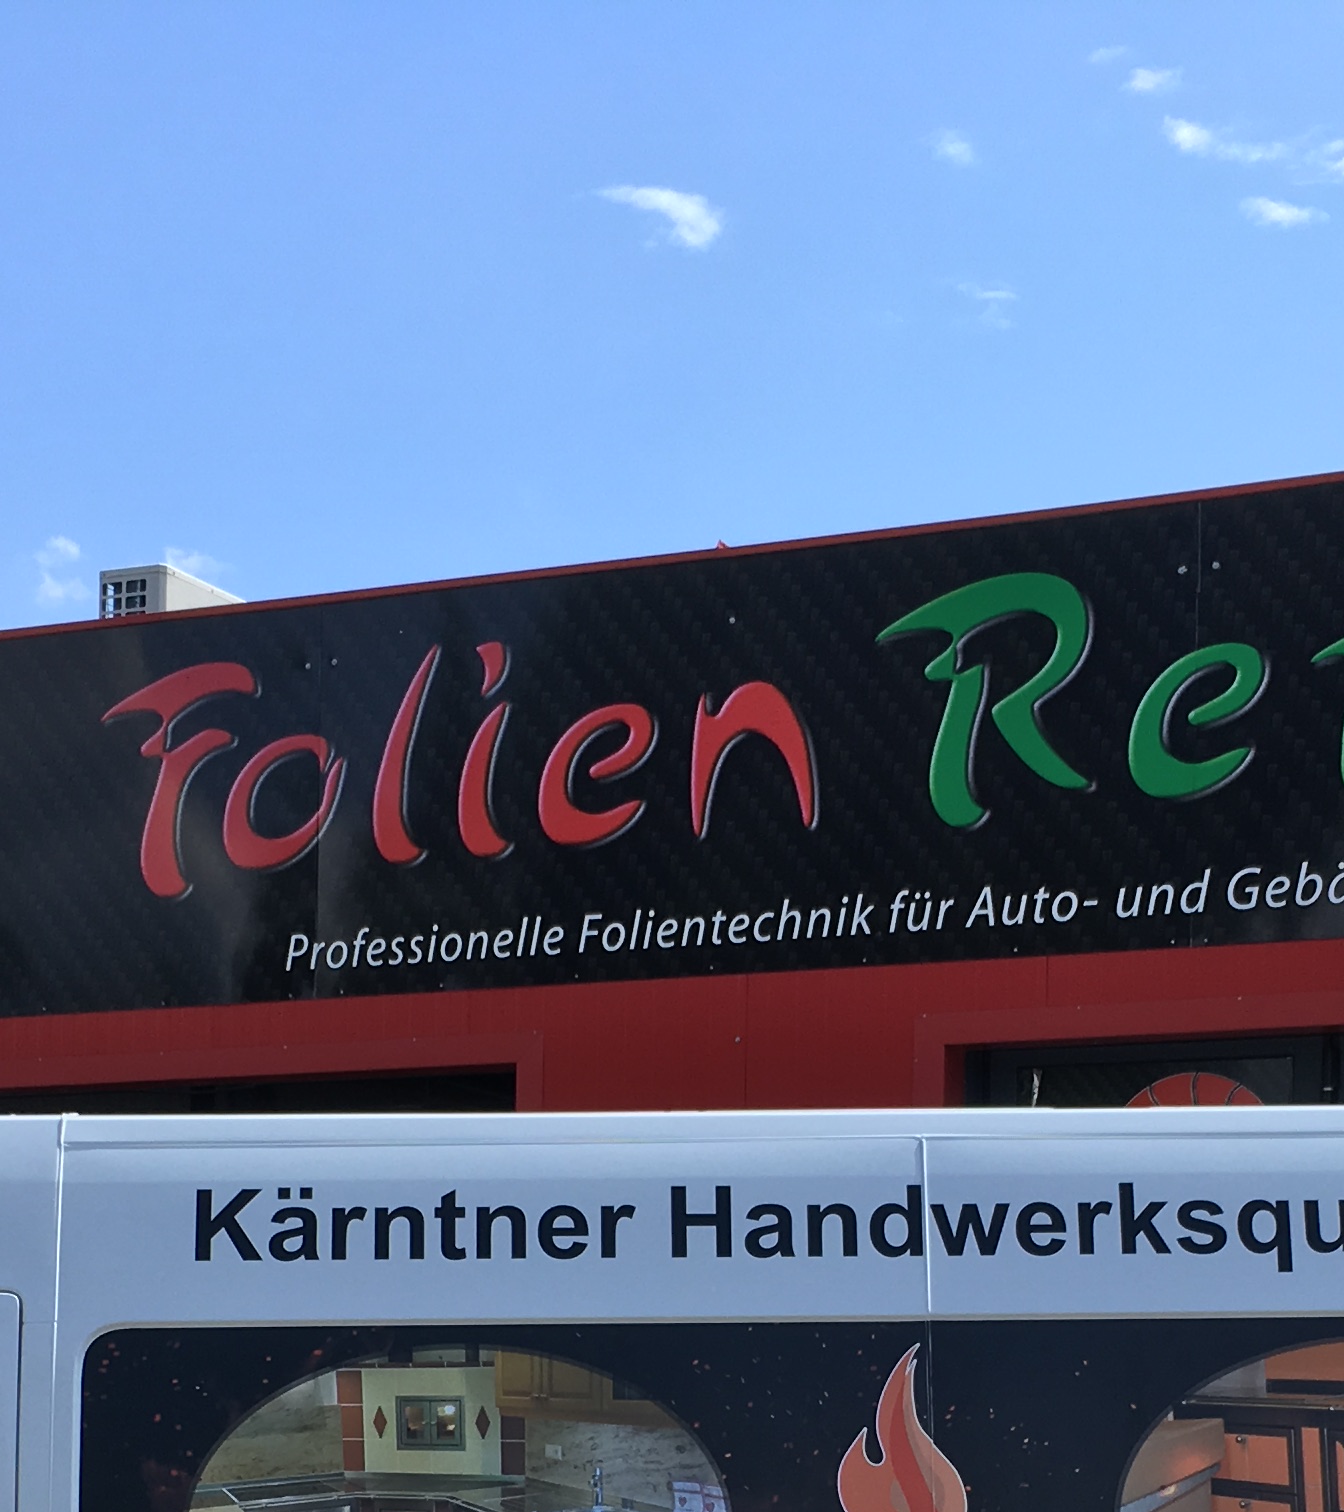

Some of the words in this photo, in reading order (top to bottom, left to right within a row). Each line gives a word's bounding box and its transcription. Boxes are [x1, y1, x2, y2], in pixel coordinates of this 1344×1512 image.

[102, 641, 820, 901] Folien
[284, 913, 564, 972] Professionelle
[577, 893, 873, 955] Folientechnik
[887, 889, 955, 934] für
[965, 884, 1098, 930] Auto-
[1115, 868, 1209, 918] und
[194, 1187, 637, 1262] Kärntner
